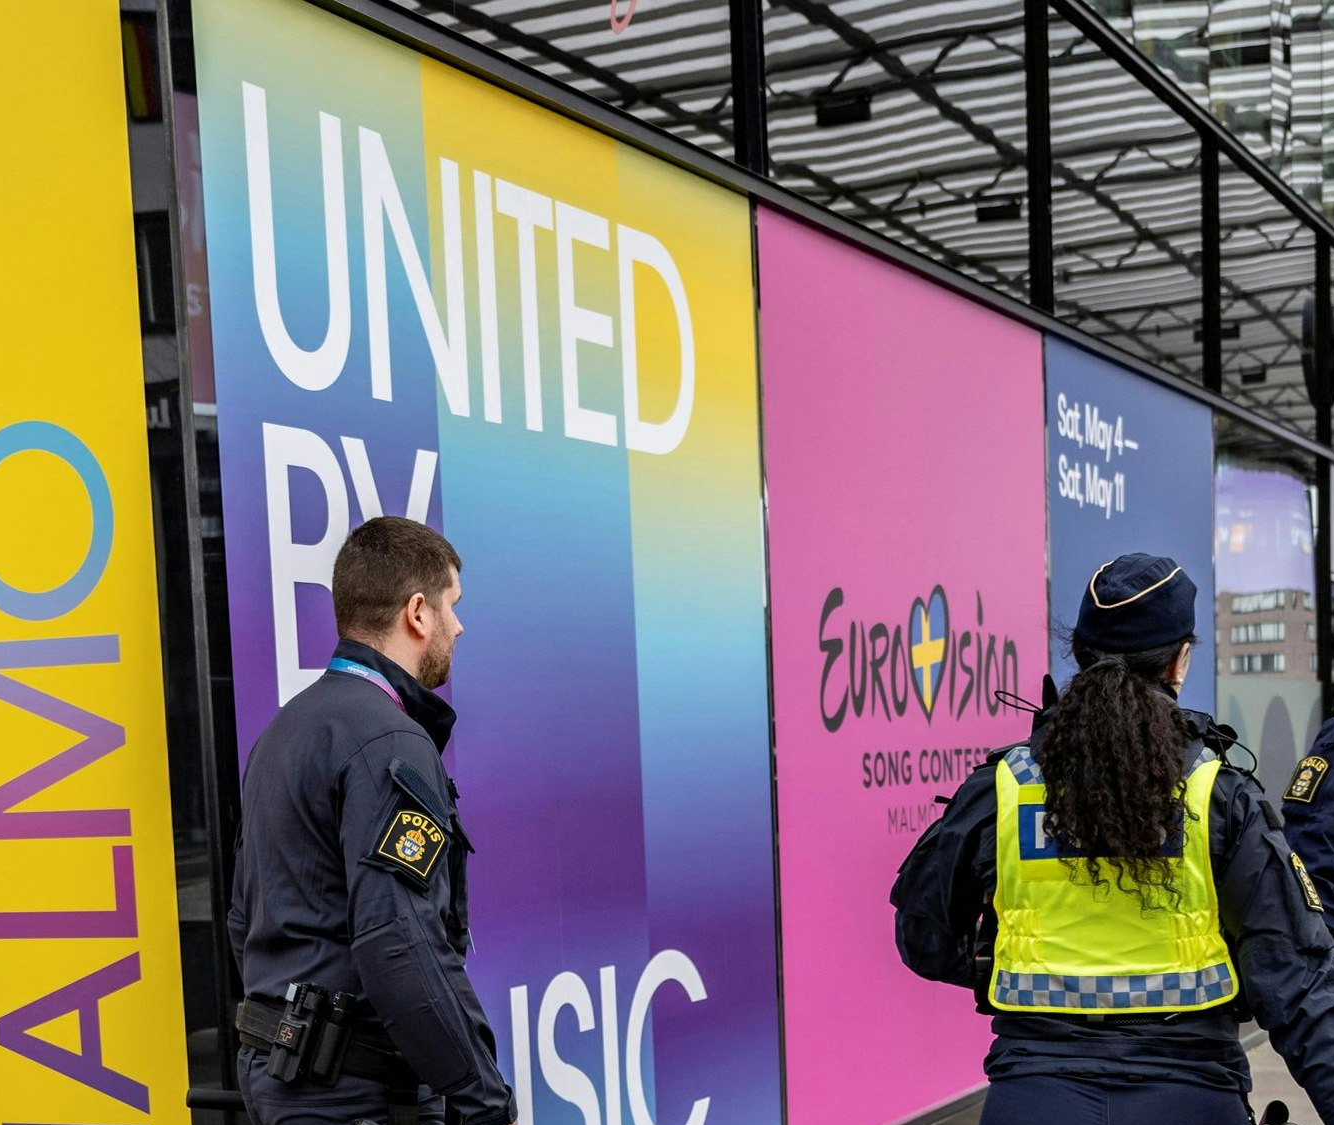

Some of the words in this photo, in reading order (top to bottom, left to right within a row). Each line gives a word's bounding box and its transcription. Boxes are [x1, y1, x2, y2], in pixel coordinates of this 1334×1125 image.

[242, 80, 696, 456] UNITED
[1057, 391, 1084, 449] Sat,
[1085, 403, 1114, 462] May
[1058, 453, 1085, 509] Sat,
[1085, 462, 1114, 520] May
[1114, 472, 1125, 513] 11
[862, 752, 913, 789] SONG
[401, 813, 441, 843] POLIS
